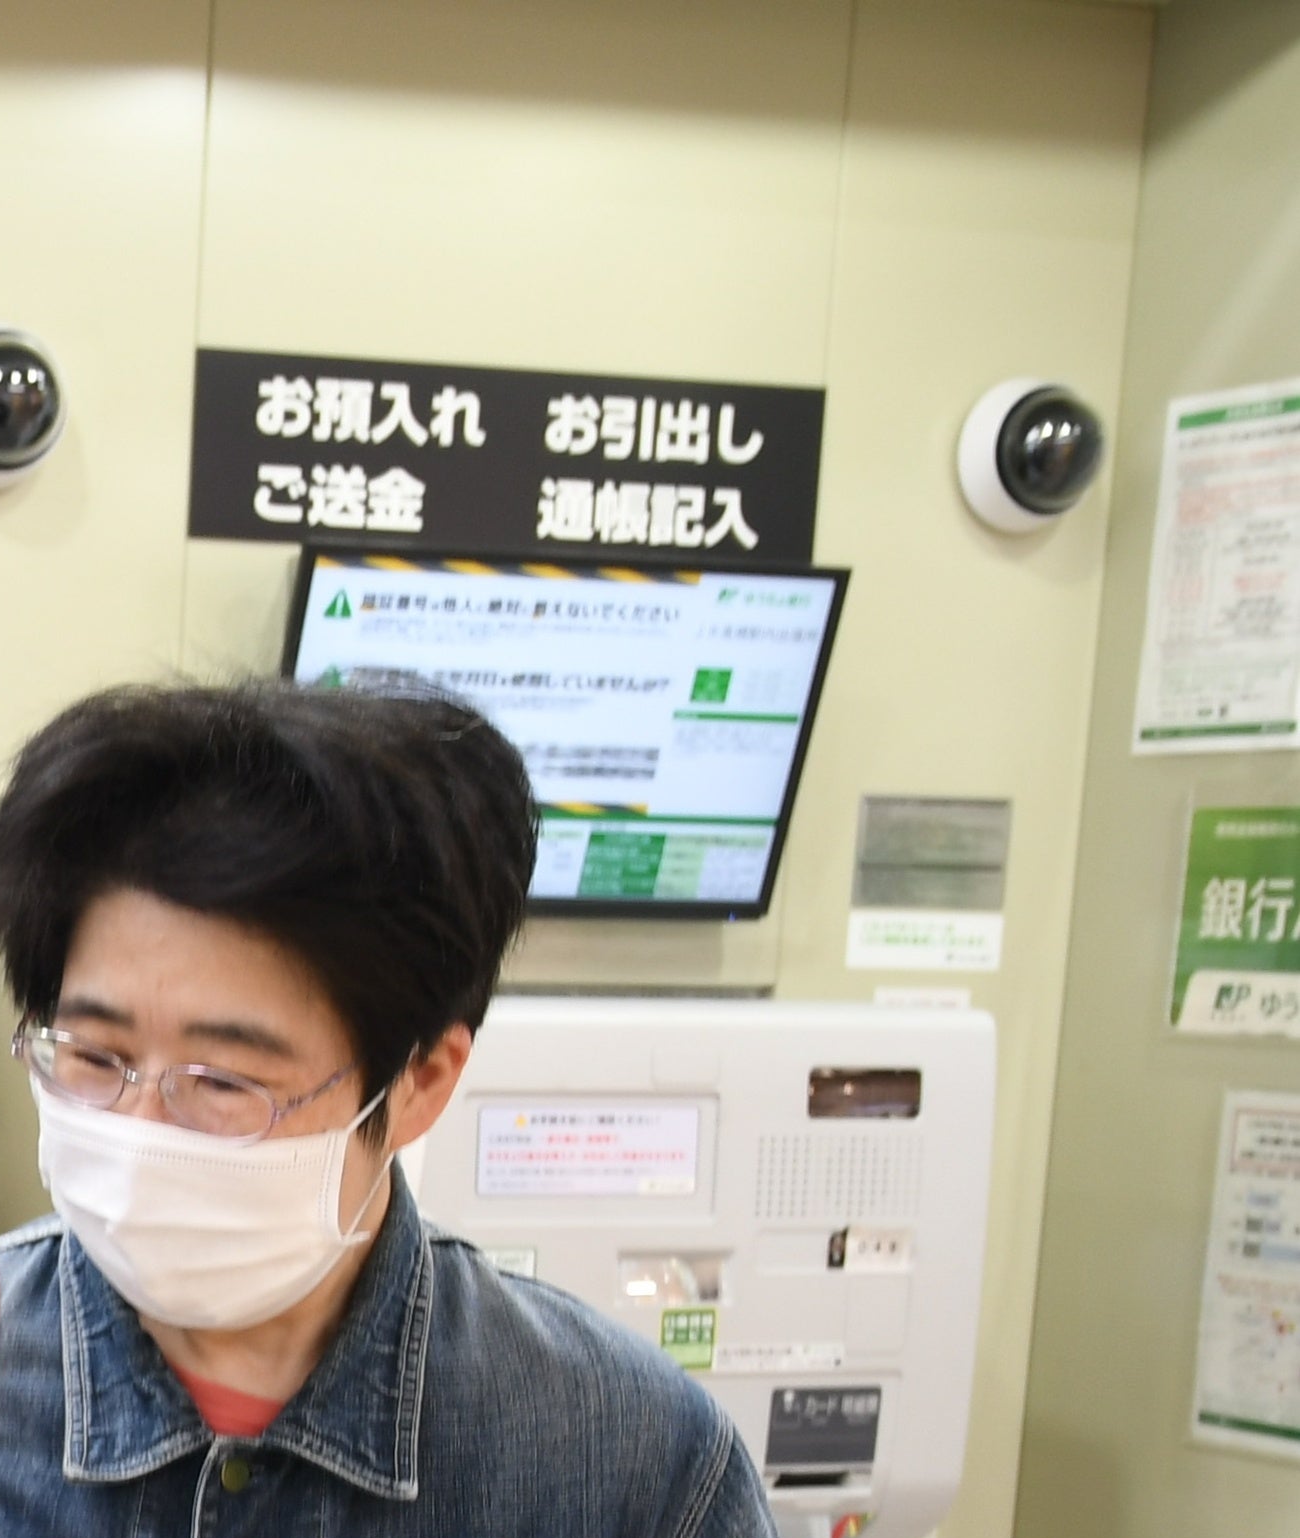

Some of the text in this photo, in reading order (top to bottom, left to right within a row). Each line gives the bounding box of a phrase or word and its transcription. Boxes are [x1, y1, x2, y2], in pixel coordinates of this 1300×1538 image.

[255, 375, 763, 465] お預入れ お引出し
[253, 464, 758, 550] ご送金 通帳記入
[1200, 876, 1300, 943] 銀行
